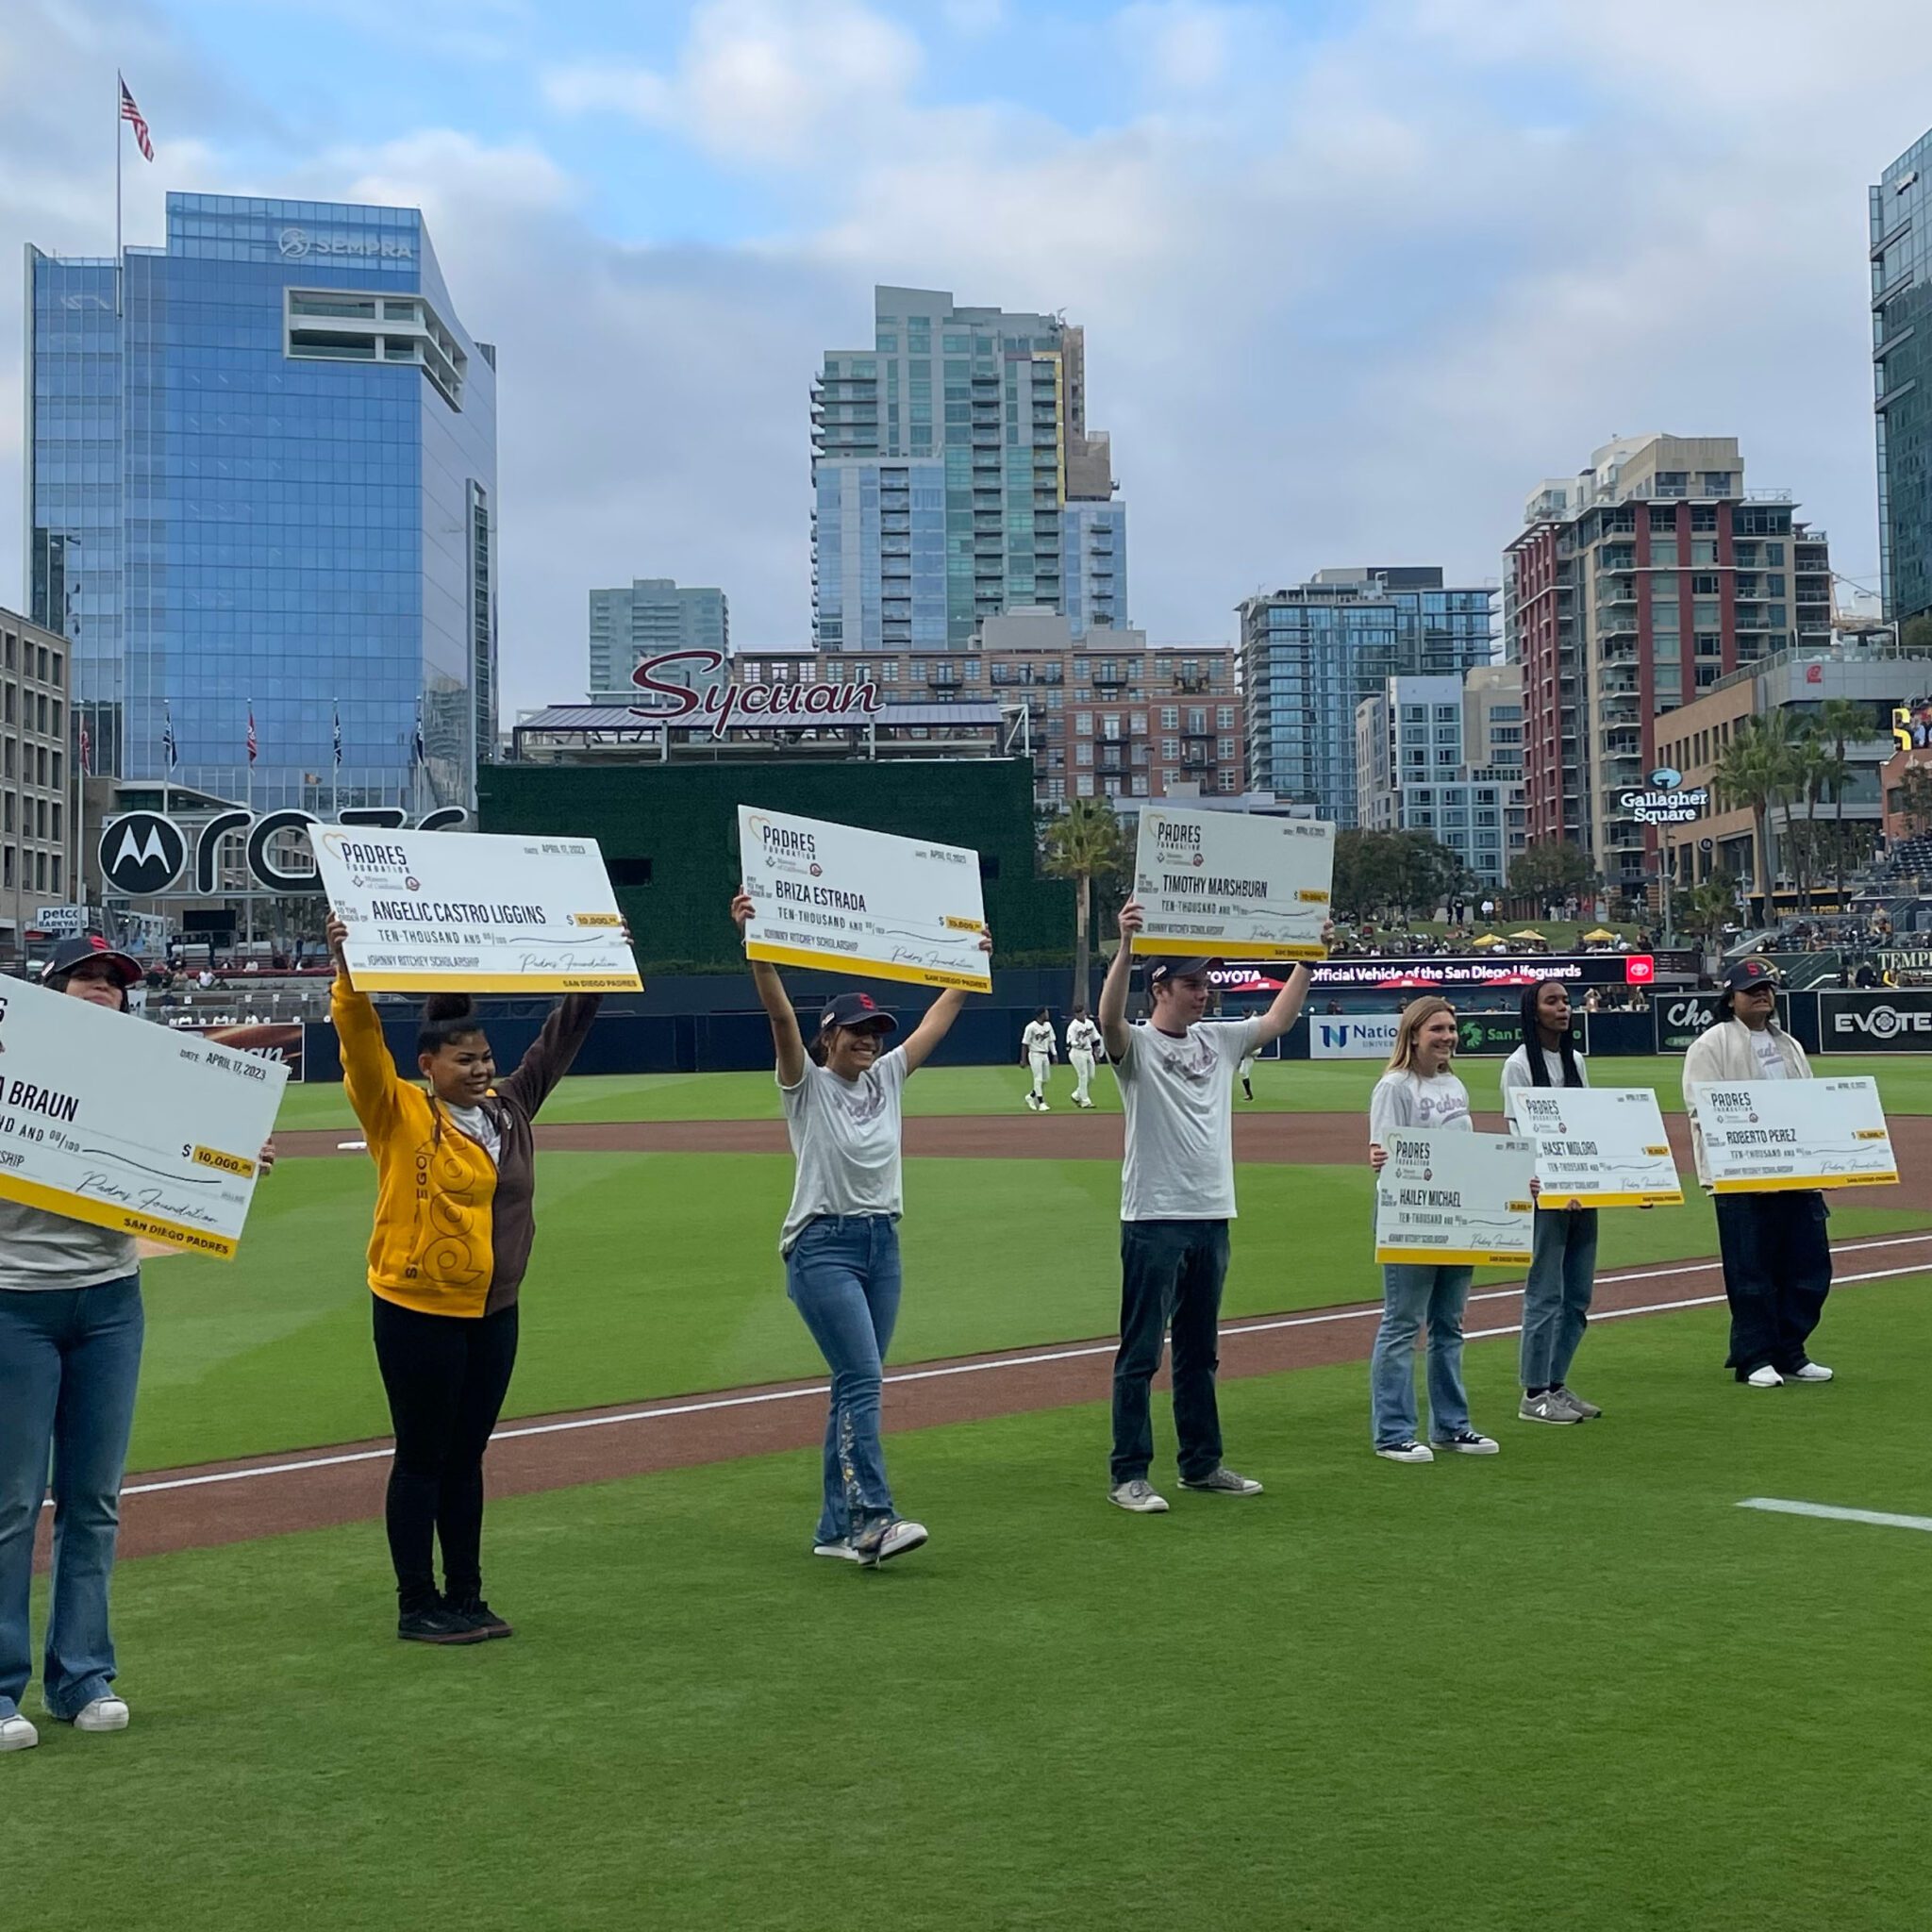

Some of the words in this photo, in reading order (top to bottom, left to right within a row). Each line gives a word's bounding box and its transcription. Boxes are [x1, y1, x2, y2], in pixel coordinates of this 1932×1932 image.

[316, 238, 412, 258] SEMPRA
[628, 649, 886, 739] Sycuan
[1621, 791, 1707, 808] Gallagher
[1634, 808, 1697, 825] Square
[762, 825, 815, 853] PADRES
[1158, 822, 1201, 843] PADRES
[341, 842, 407, 865] PADRES
[775, 879, 811, 903] BRIZA
[813, 886, 867, 912] ESTRADA
[1163, 874, 1207, 894] TIMOTHY
[1208, 877, 1268, 899] MARSHBURN
[372, 900, 433, 921] ANGELIC
[434, 903, 491, 924] CASTRO
[491, 905, 547, 924] LIGGINS
[566, 914, 574, 925] $
[777, 907, 846, 929] TEN-THOUSAND
[938, 915, 944, 926] $
[377, 929, 460, 944] TEN-THOUSAND
[464, 934, 481, 944] AND
[1356, 966, 1404, 981] Vehicle
[1421, 965, 1444, 980] the
[1444, 966, 1471, 979] San
[1472, 965, 1511, 980] Diego
[1354, 1024, 1398, 1039] Natio
[1488, 1028, 1512, 1041] San
[206, 1052, 232, 1070] APRIL
[243, 1064, 267, 1081] 2023
[8, 1080, 79, 1123] BRAUN
[1525, 1099, 1559, 1116] PADRES
[1710, 1091, 1752, 1107] PADRES
[18, 1124, 44, 1141] AND
[1725, 1130, 1768, 1144] ROBERTO
[1768, 1128, 1797, 1143] PEREZ
[181, 1143, 192, 1158] $
[1396, 1140, 1431, 1159] PADRES
[1541, 1141, 1566, 1157] HASET
[1400, 1188, 1427, 1207] HAILEY
[1428, 1191, 1462, 1208] MICHAEL
[124, 1216, 148, 1231] SAN
[149, 1223, 185, 1242] DIEGO
[186, 1235, 229, 1255] PADRES
